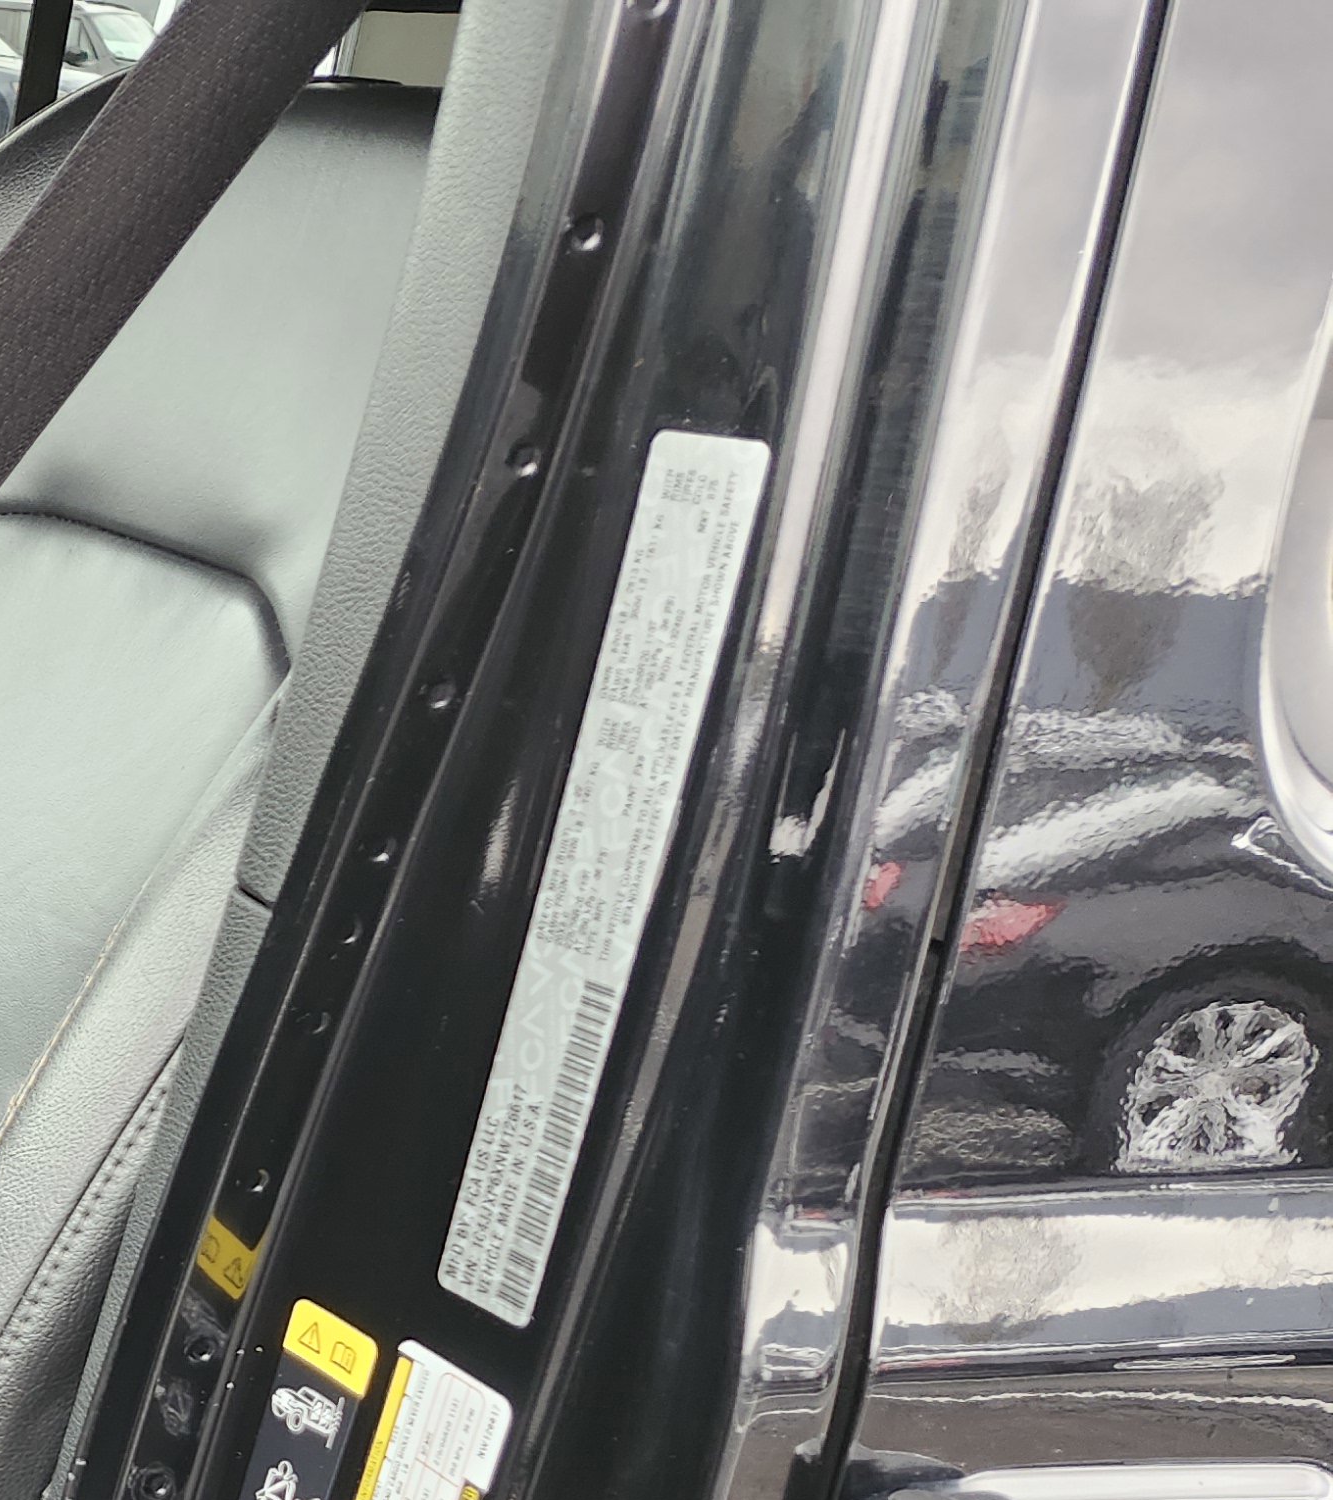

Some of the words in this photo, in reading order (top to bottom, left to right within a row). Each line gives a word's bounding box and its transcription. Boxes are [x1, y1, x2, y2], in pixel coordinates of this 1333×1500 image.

[478, 1113, 500, 1147] LLC
[470, 1146, 491, 1174] US
[462, 1172, 484, 1208] FCA
[474, 1227, 506, 1298] VEHICLE
[493, 1177, 521, 1229] MADE
[443, 1240, 465, 1281] MFD
